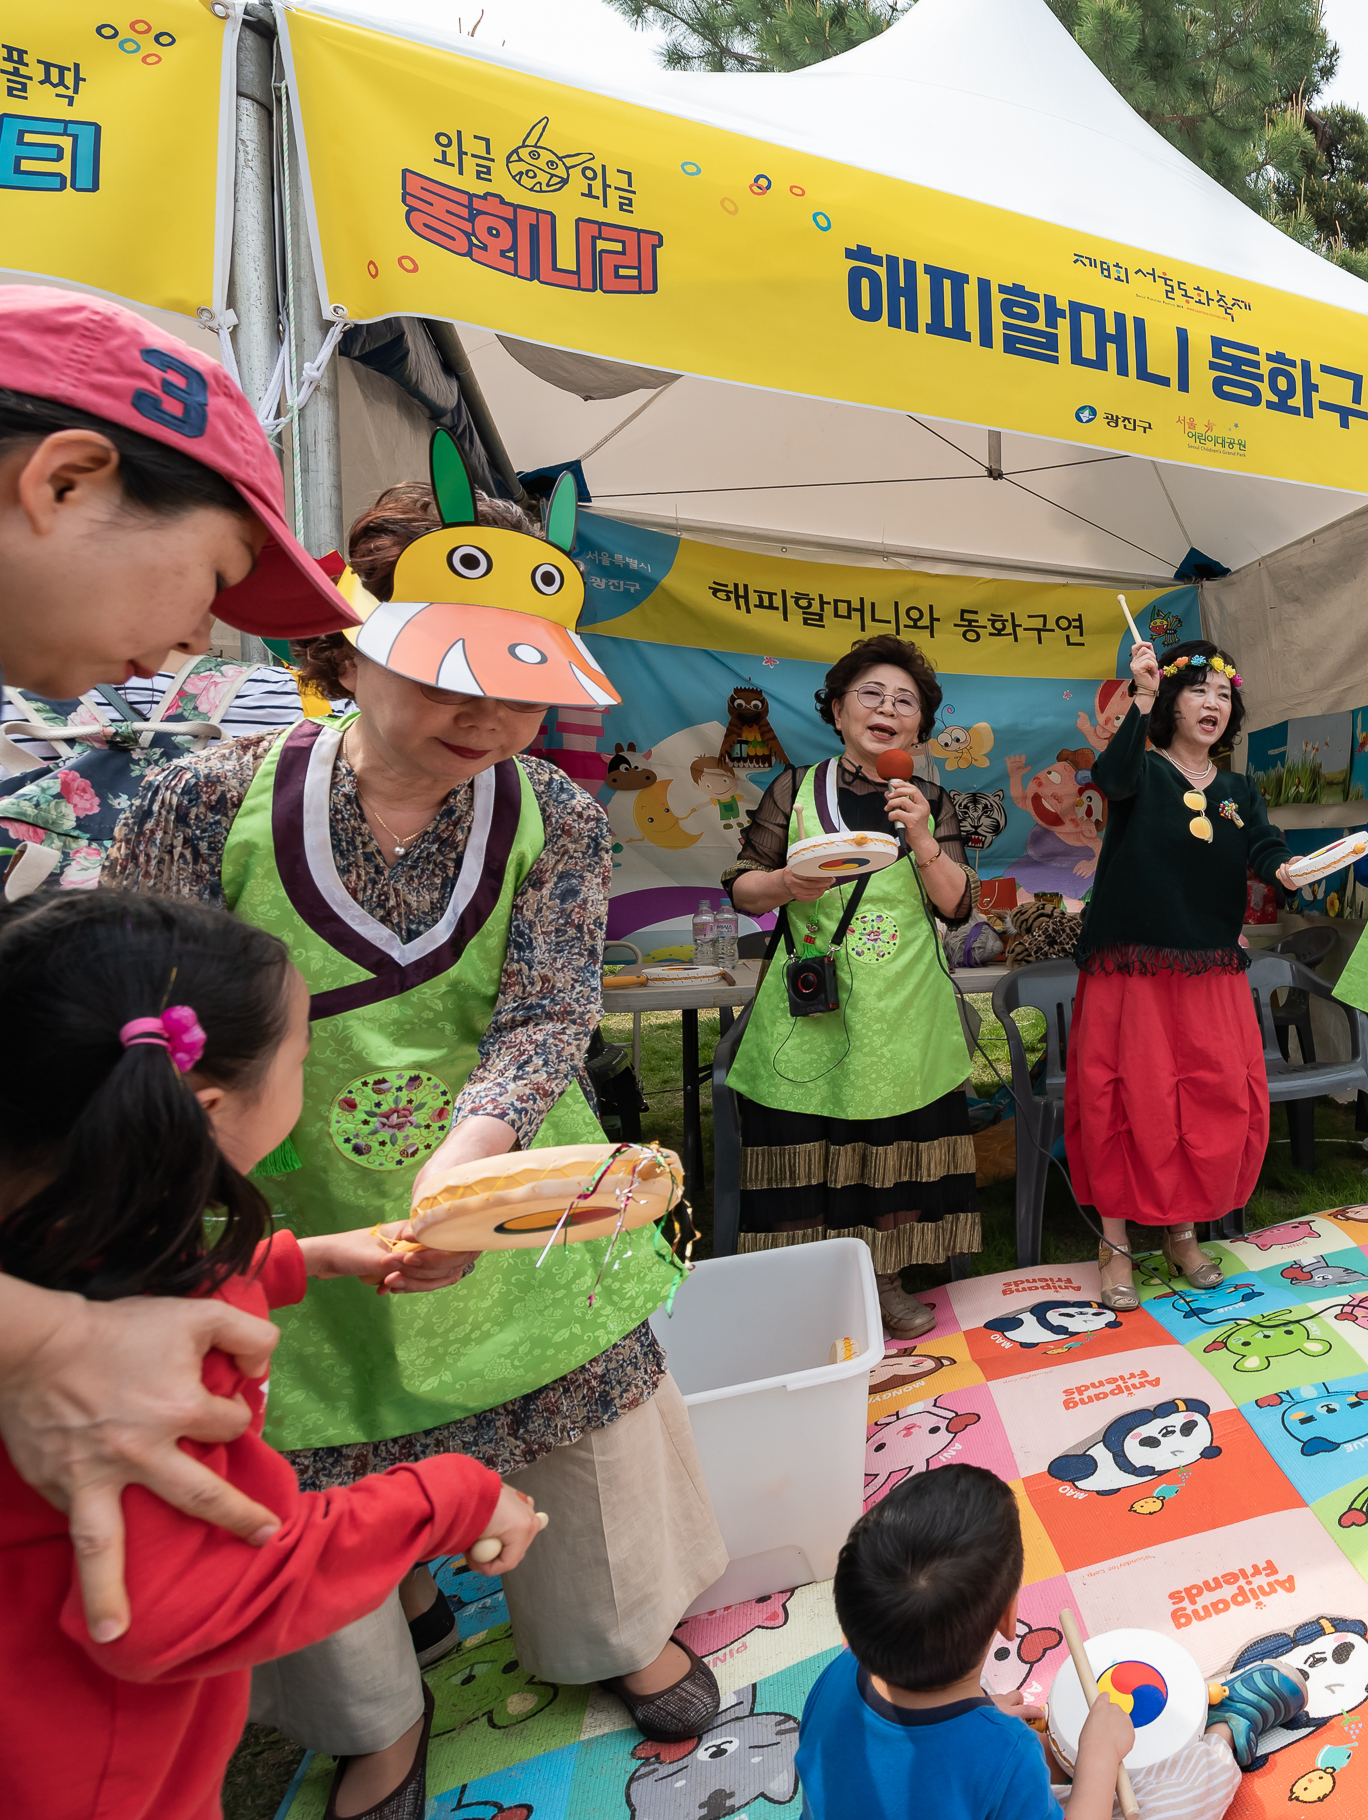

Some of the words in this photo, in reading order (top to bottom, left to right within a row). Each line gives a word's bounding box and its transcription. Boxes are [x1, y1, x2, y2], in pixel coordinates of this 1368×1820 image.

[0, 43, 87, 107] 폴짝
[434, 129, 496, 183] 와글
[580, 165, 637, 214] 와글
[1134, 267, 1252, 322] 서울동화축제
[844, 244, 1190, 393] 해피할머니
[131, 347, 209, 439] 3
[1103, 411, 1154, 434] 광진구
[1176, 415, 1198, 434] 서울
[1187, 431, 1247, 452] 어린이대공원
[586, 550, 651, 573] 서울특별시
[589, 576, 641, 593] 광진구
[708, 580, 940, 638] 해피할머니와
[953, 608, 1086, 648] 동화구연
[1001, 1283, 1082, 1296] Anipang
[1002, 1277, 1074, 1288] Friends
[1217, 1302, 1245, 1314] BLUE
[990, 1334, 1014, 1349] MAO
[1062, 1369, 1150, 1397] Friends
[1063, 1376, 1162, 1411] Anipang
[938, 1442, 962, 1462] ANI
[1058, 1485, 1089, 1500] MAO
[1168, 1559, 1279, 1606] Friends
[1170, 1574, 1296, 1630] Anipang
